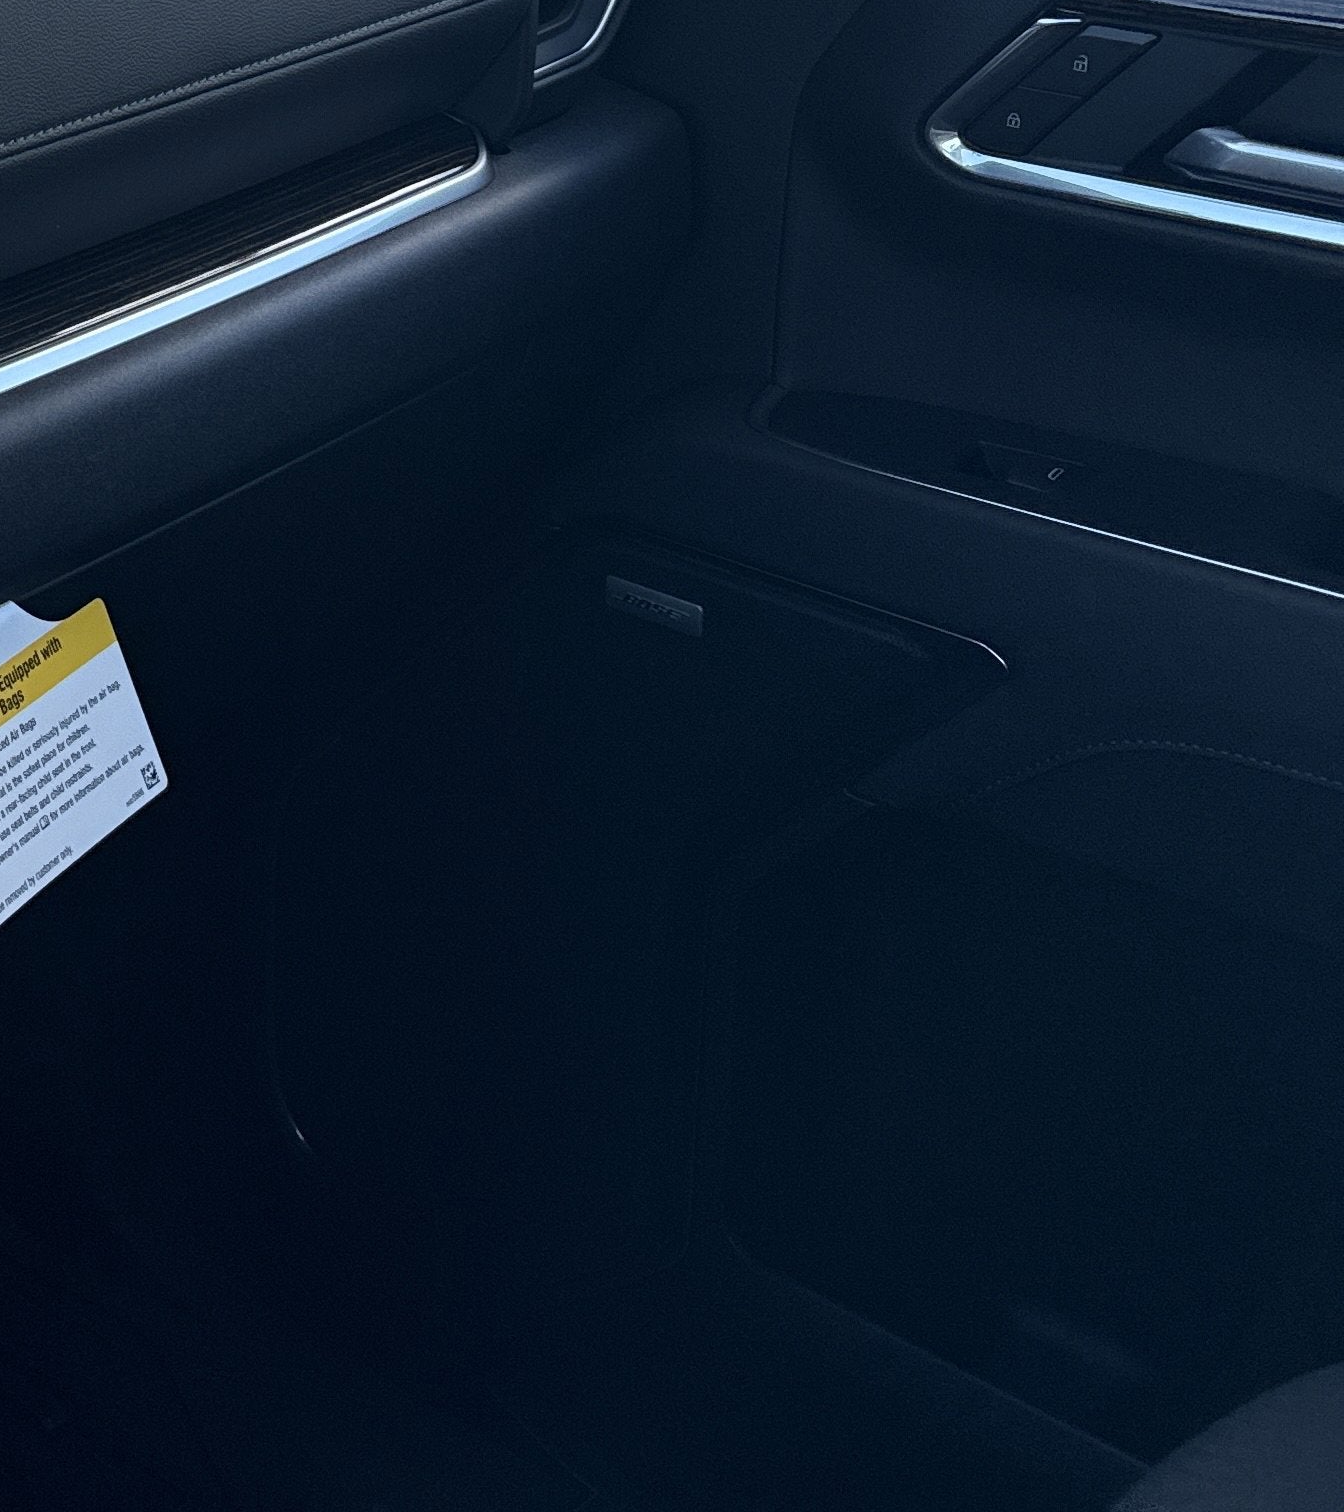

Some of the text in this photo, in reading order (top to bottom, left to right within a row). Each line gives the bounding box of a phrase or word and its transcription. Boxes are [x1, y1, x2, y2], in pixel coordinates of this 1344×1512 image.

[39, 636, 62, 660] with
[5, 750, 25, 770] killed
[78, 703, 88, 714] by
[87, 695, 98, 708] the
[98, 688, 107, 700] air
[9, 729, 19, 742] Air
[18, 717, 37, 734] Bags
[11, 774, 23, 787] the
[56, 740, 65, 753] for
[36, 771, 52, 789] child
[51, 761, 65, 778] seat
[70, 750, 81, 763] the
[10, 814, 24, 832] seat
[22, 804, 39, 821] belts
[38, 793, 51, 809] and
[50, 782, 65, 800] child
[18, 822, 40, 847] manual
[49, 809, 58, 821] for
[58, 797, 74, 814] more
[72, 773, 105, 802] information
[104, 759, 121, 778] about
[120, 754, 129, 766] air
[4, 877, 31, 907] removed
[34, 854, 60, 880] customer
